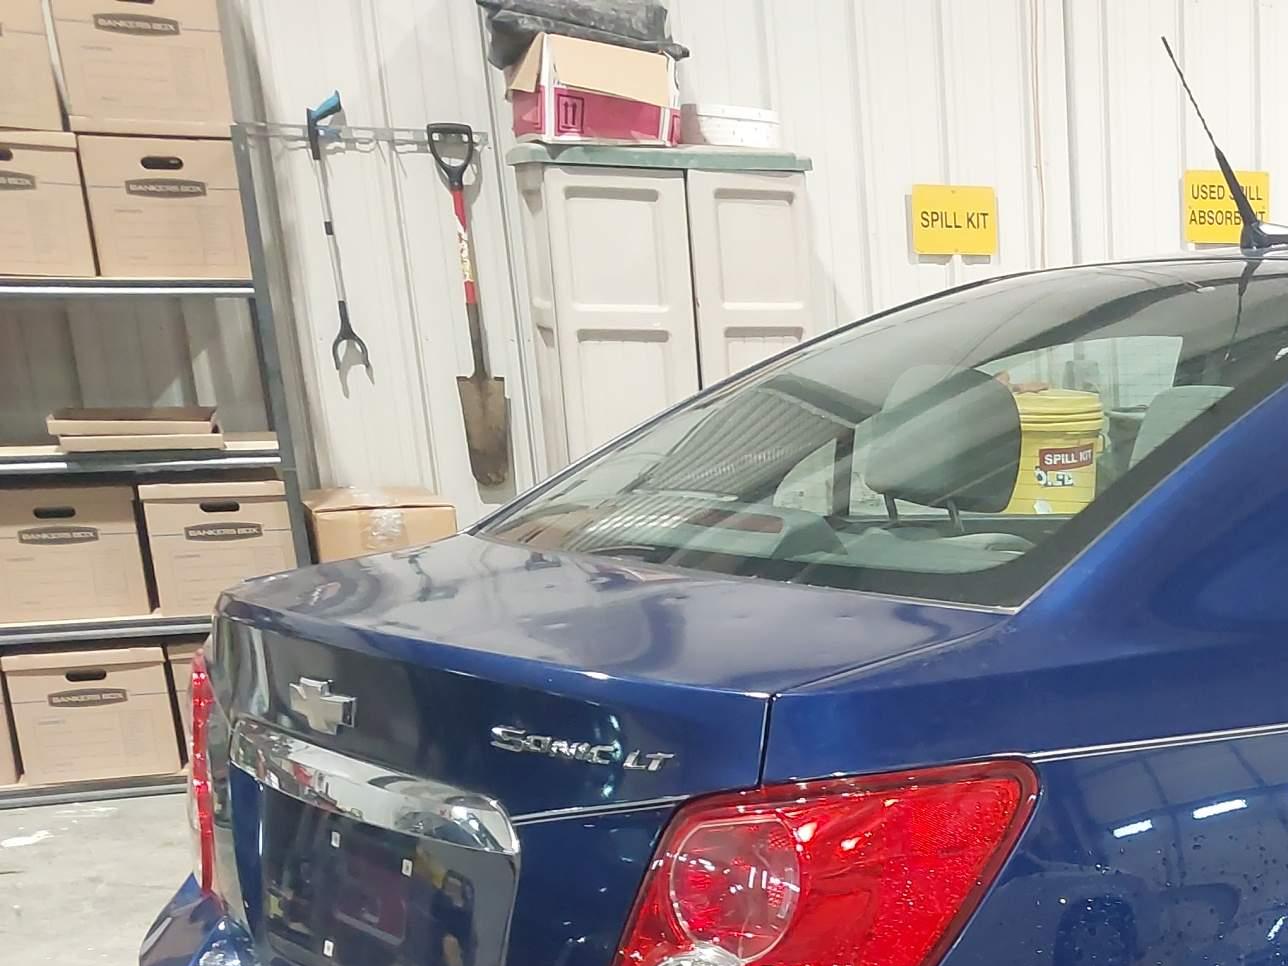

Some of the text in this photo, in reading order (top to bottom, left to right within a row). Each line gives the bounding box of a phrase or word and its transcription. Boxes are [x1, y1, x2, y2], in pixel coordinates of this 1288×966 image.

[1191, 184, 1225, 200] USED
[920, 210, 989, 229] SPILL KIT
[1189, 209, 1266, 226] ABSORBT
[1043, 448, 1092, 465] SPILL KIT
[622, 749, 676, 772] LT
